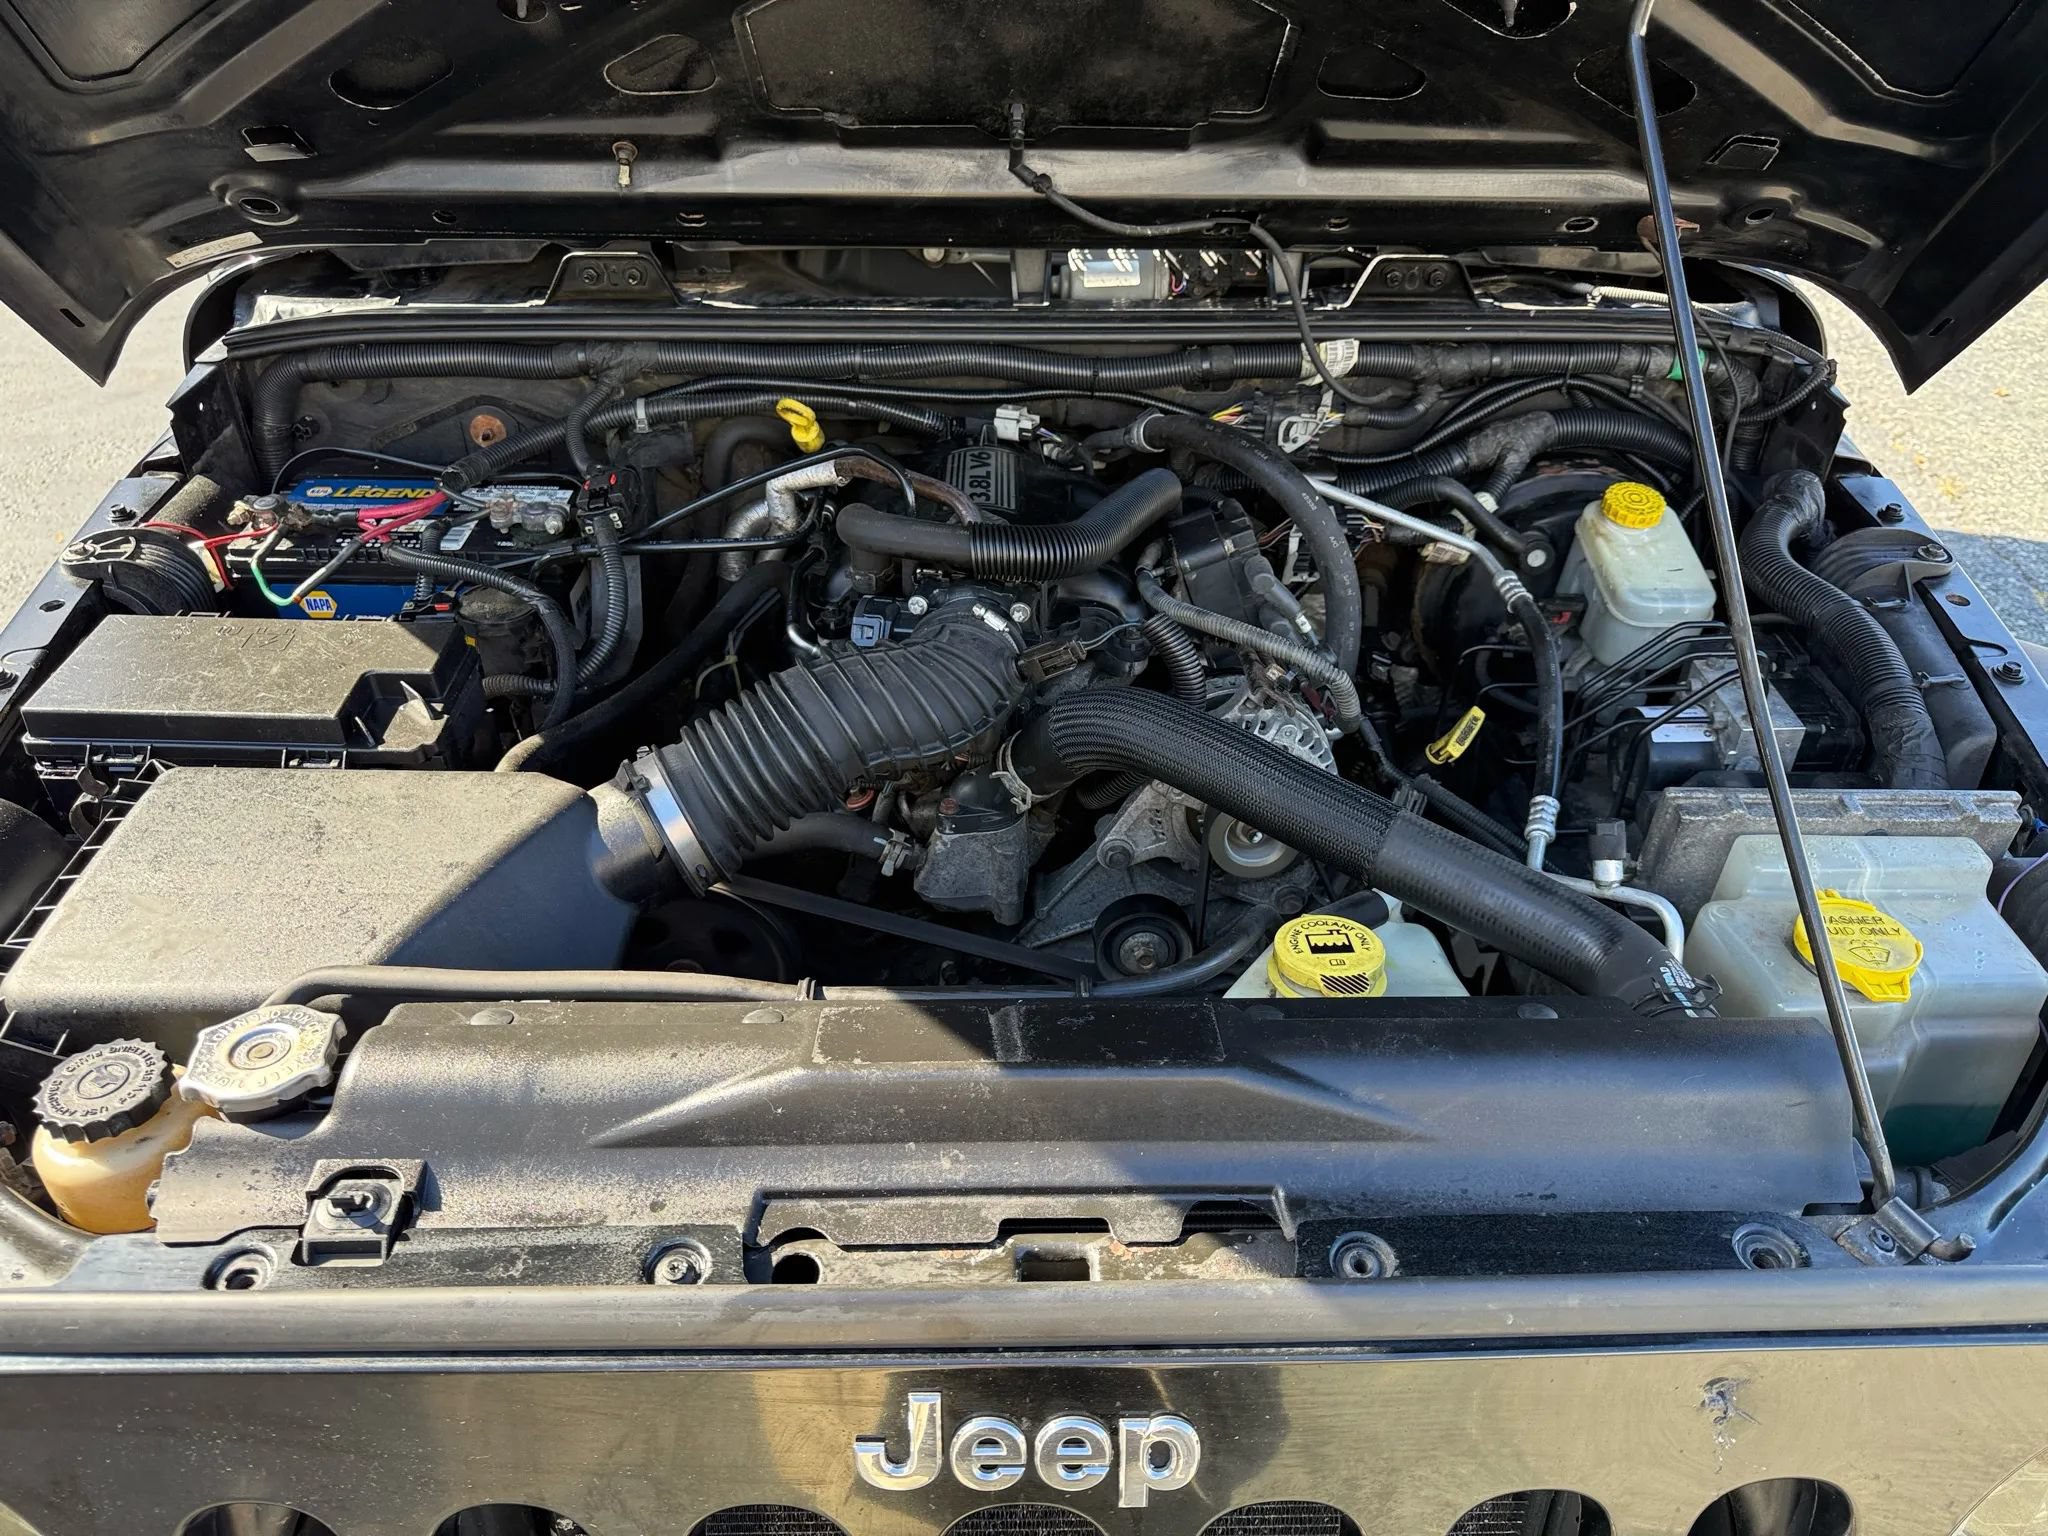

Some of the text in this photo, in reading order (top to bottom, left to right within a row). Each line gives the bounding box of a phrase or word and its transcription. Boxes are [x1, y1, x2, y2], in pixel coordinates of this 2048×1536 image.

[968, 451, 992, 502] 3.8L V6
[333, 488, 438, 498] LEGEND
[305, 598, 333, 611] NAPA
[1290, 920, 1371, 955] ENGINE COOLANT ONLY
[1827, 926, 1901, 936] UID ONLY
[854, 1391, 1201, 1508] Jeep
